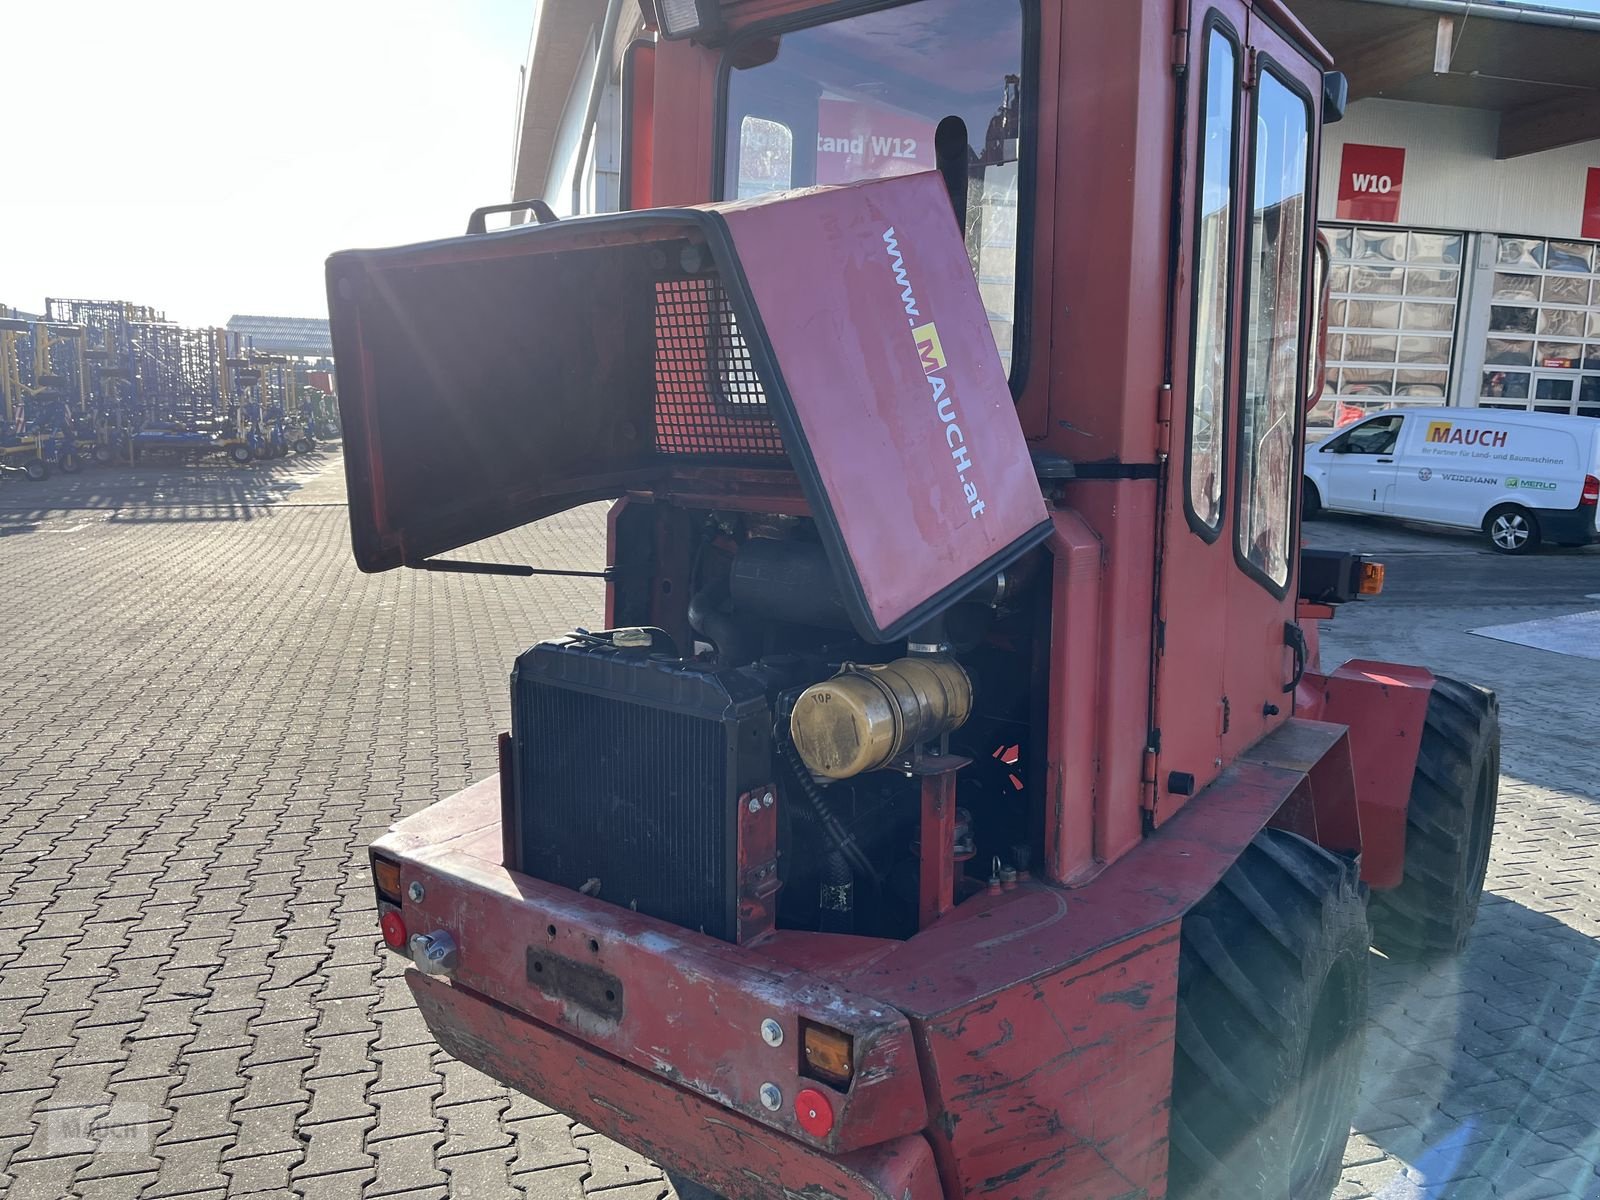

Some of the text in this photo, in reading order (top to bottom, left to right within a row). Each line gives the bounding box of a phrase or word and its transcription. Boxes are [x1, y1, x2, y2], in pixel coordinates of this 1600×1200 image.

[871, 136, 917, 158] W12
[1352, 173, 1392, 194] W10
[882, 226, 985, 519] www.MAUCH.at
[1431, 427, 1508, 448] MAUCH
[1433, 448, 1458, 456] Partner
[1459, 449, 1470, 457] für
[1472, 451, 1491, 459] Land-
[1493, 453, 1508, 461] und
[1509, 454, 1564, 465] Baumaschinen
[1442, 473, 1498, 486] WEIDEMANN
[1520, 480, 1557, 489] MERLO
[810, 693, 832, 704] TOP
